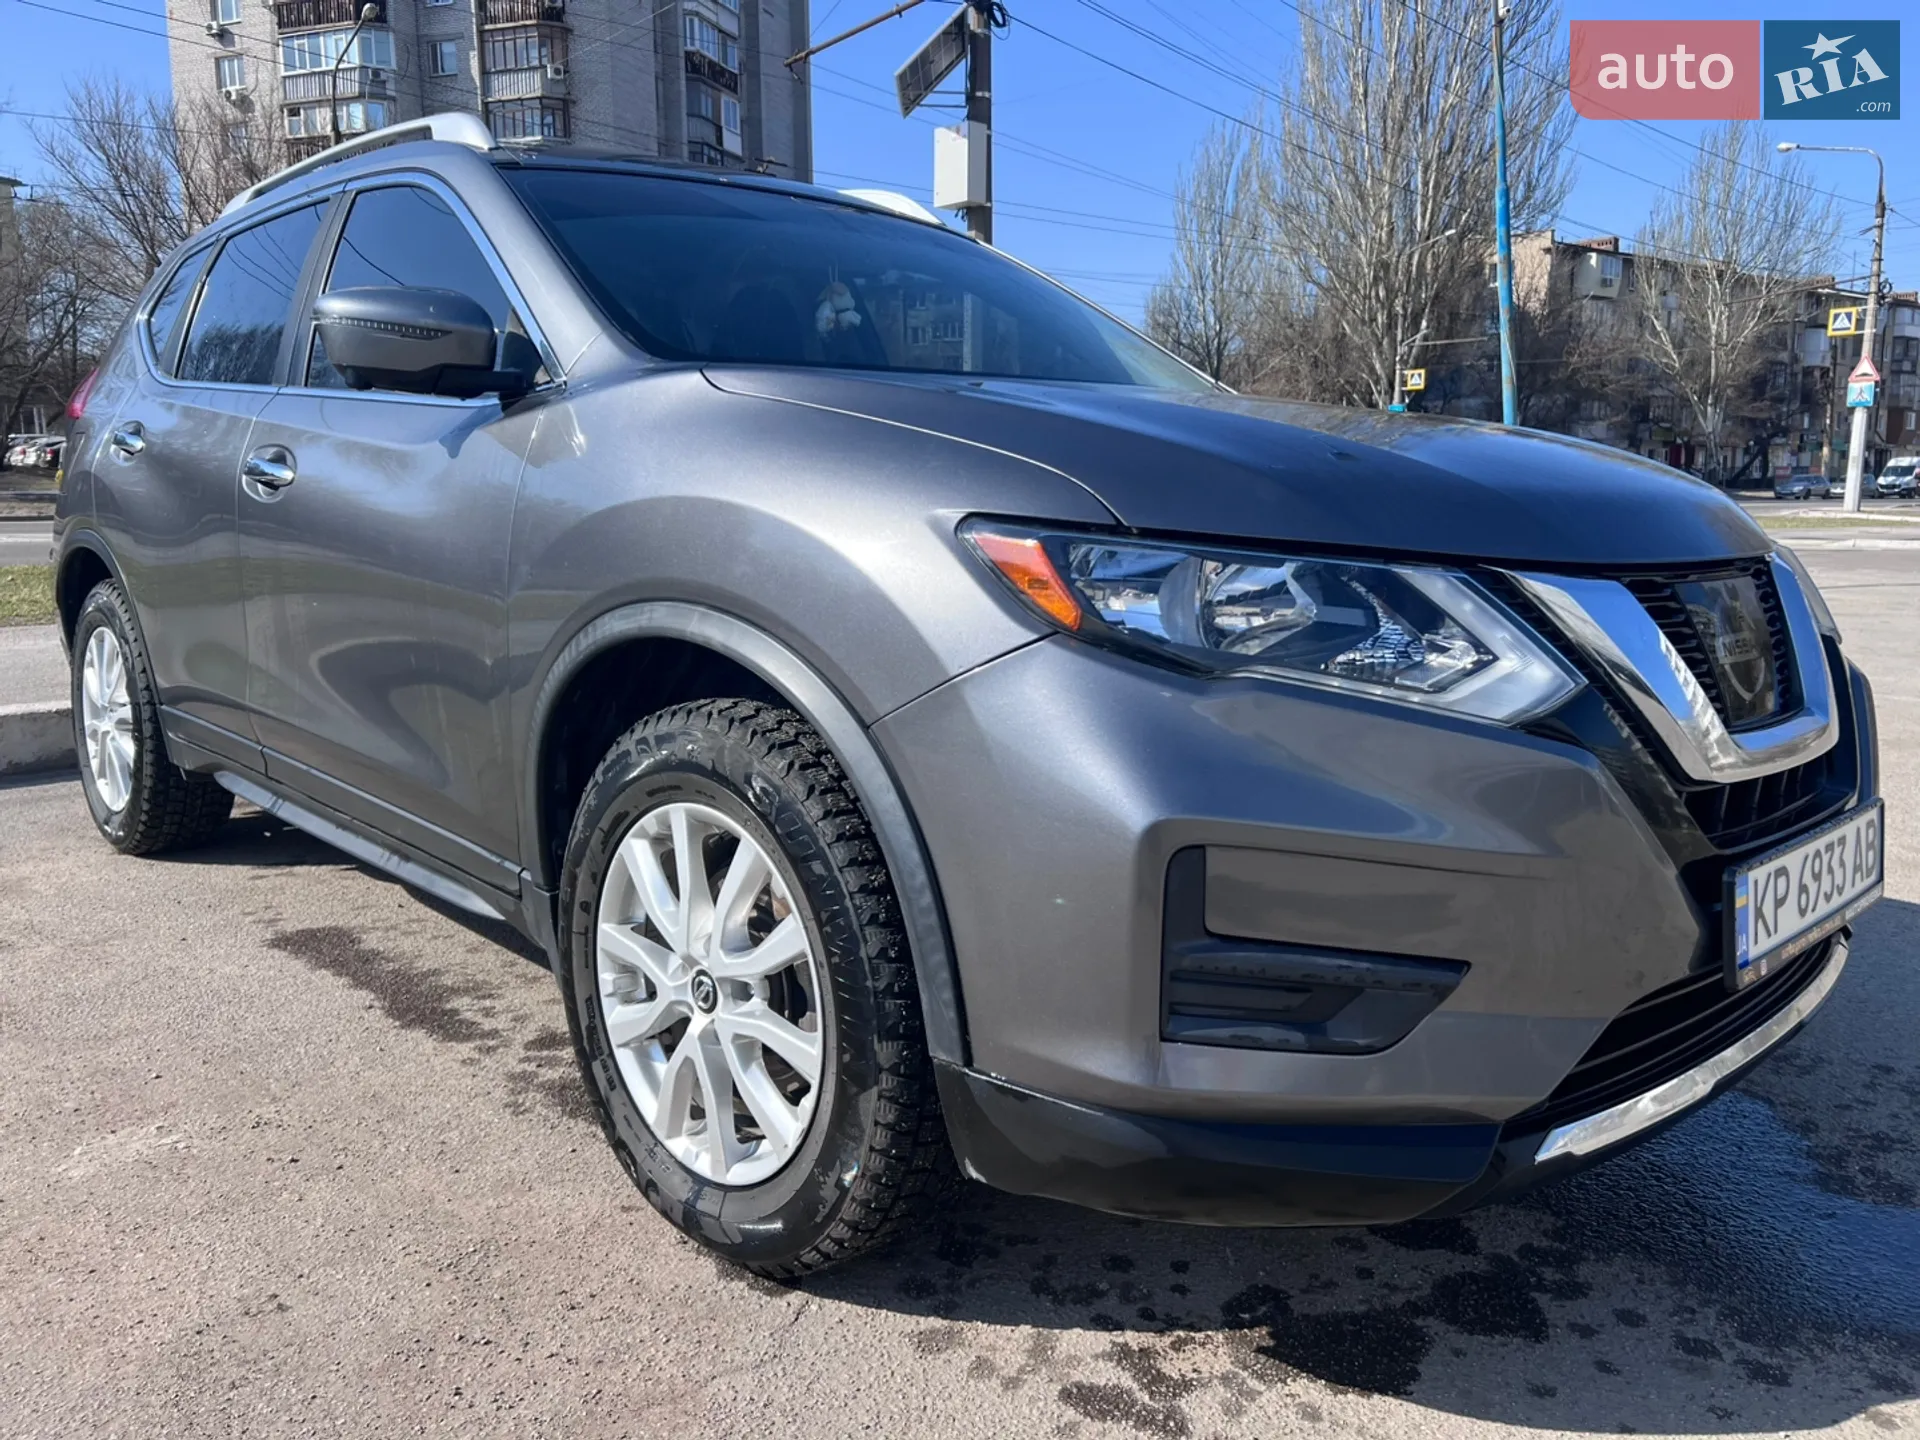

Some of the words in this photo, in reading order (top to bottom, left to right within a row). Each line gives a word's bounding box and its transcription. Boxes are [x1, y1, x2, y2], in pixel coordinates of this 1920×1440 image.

[1753, 866, 1790, 947] KP
[1797, 834, 1847, 920] 6933
[1852, 818, 1877, 888] AB
